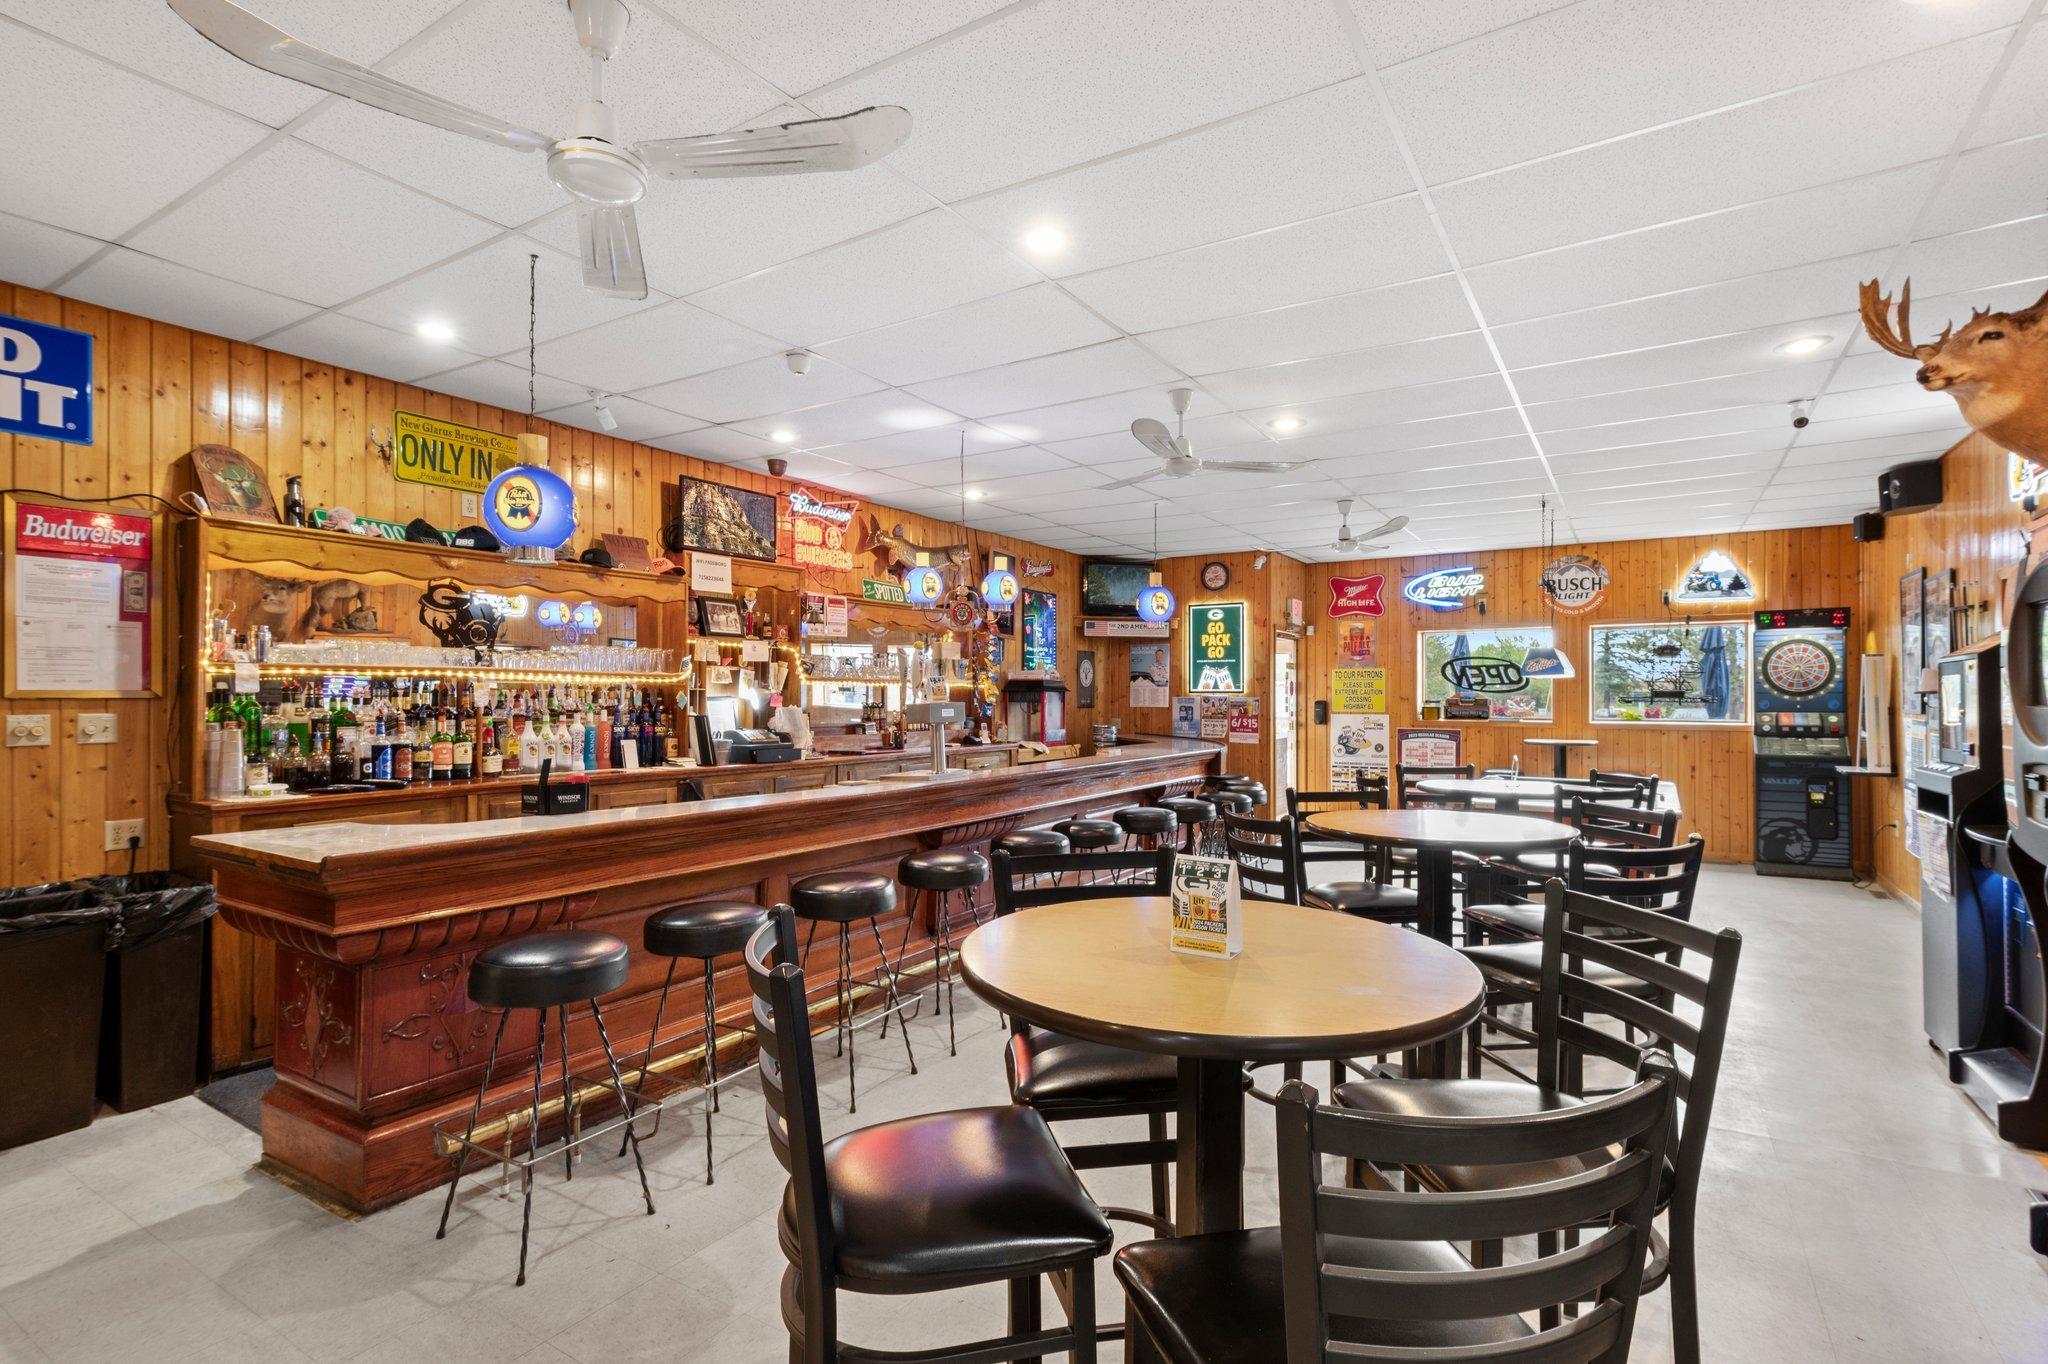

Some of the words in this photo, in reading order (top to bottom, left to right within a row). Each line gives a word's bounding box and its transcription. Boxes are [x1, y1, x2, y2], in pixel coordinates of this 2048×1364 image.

[400, 417, 420, 430] New
[422, 423, 453, 437] Glarus
[454, 429, 489, 448] Brewing
[401, 433, 464, 476] ONLY
[470, 447, 493, 481] IN
[789, 493, 852, 522] Budweiser
[23, 514, 147, 547] Budweiser
[795, 519, 823, 545] BUD
[795, 544, 853, 570] BURGERS
[1428, 574, 1484, 588] BUD
[1547, 577, 1602, 592] BUSCH
[873, 583, 904, 602] SPOTTED
[1414, 585, 1484, 600] LIGHT
[1557, 592, 1591, 600] LIGHT
[1338, 599, 1357, 607] HIGH
[1207, 621, 1225, 635] GO
[1201, 633, 1231, 647] PACK
[1207, 646, 1225, 659] GO
[1335, 671, 1343, 679] TO
[1344, 671, 1356, 679] OUR
[1357, 670, 1383, 679] PATRONS
[1243, 718, 1258, 728] $15
[1762, 777, 1804, 785] VALLEY
[1193, 896, 1206, 905] Lite
